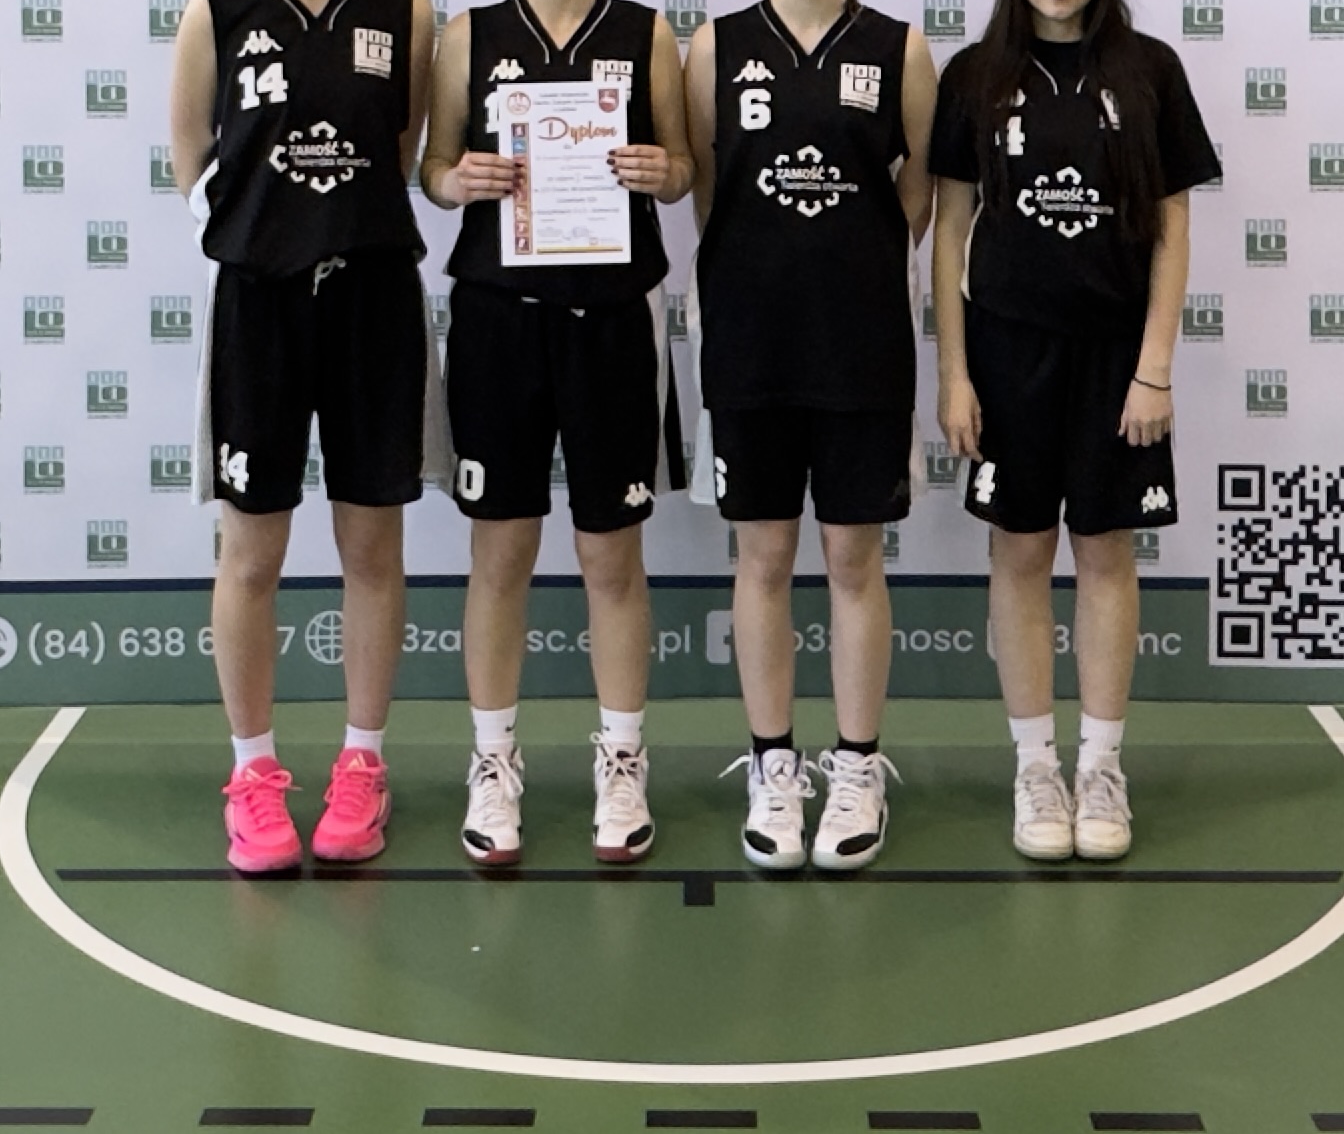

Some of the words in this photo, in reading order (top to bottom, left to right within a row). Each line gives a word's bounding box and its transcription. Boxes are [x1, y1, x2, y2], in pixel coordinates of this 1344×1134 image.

[238, 62, 289, 110] 14
[537, 116, 617, 145] Dyplom
[740, 88, 773, 131] 6
[28, 621, 106, 666] (84)
[119, 626, 186, 657] 638
